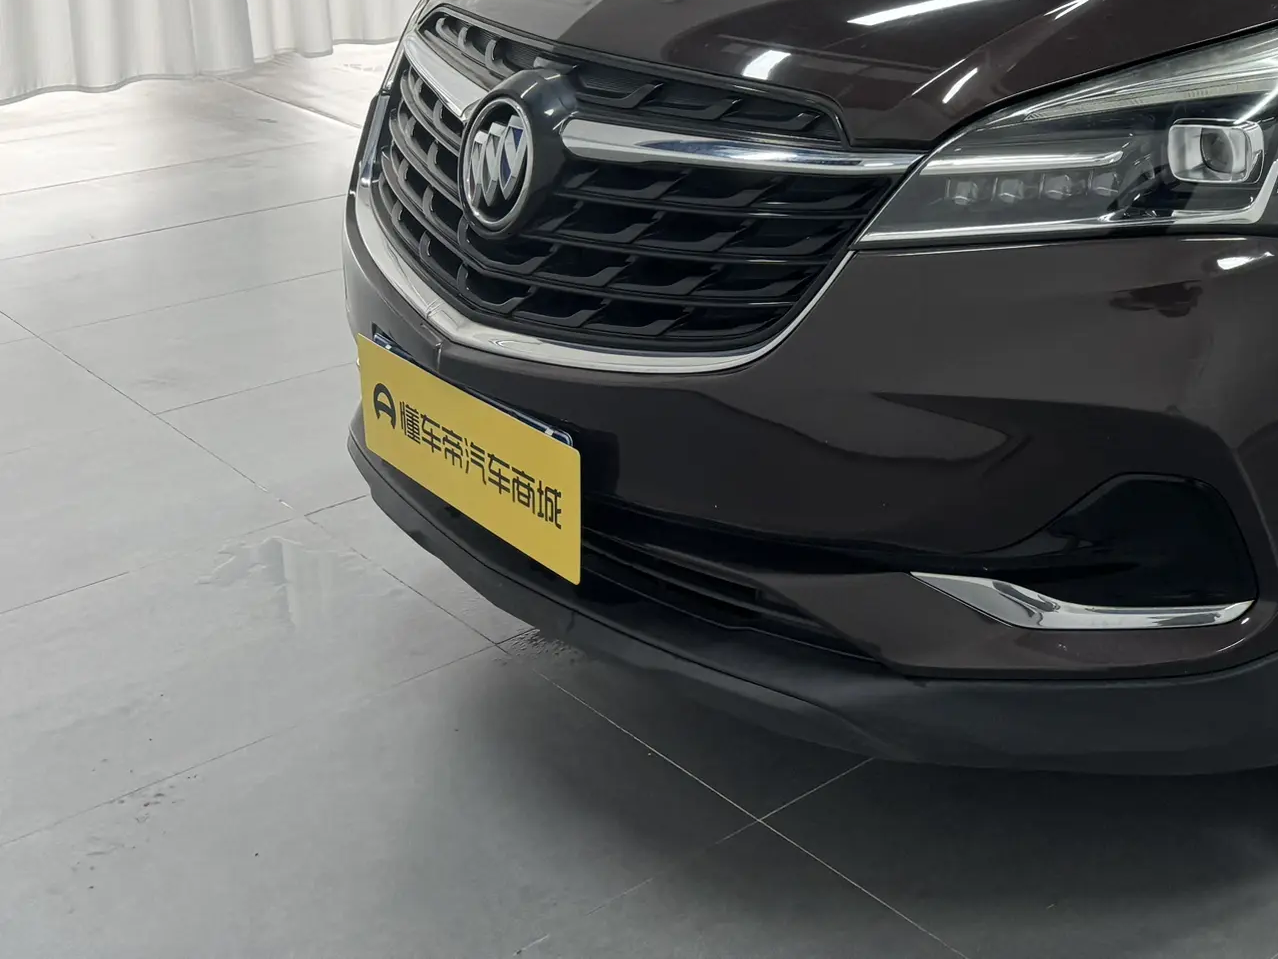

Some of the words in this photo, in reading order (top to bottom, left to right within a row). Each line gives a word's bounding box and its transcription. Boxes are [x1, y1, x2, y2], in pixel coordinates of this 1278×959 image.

[399, 400, 562, 530] 懂车帝汽车商城
